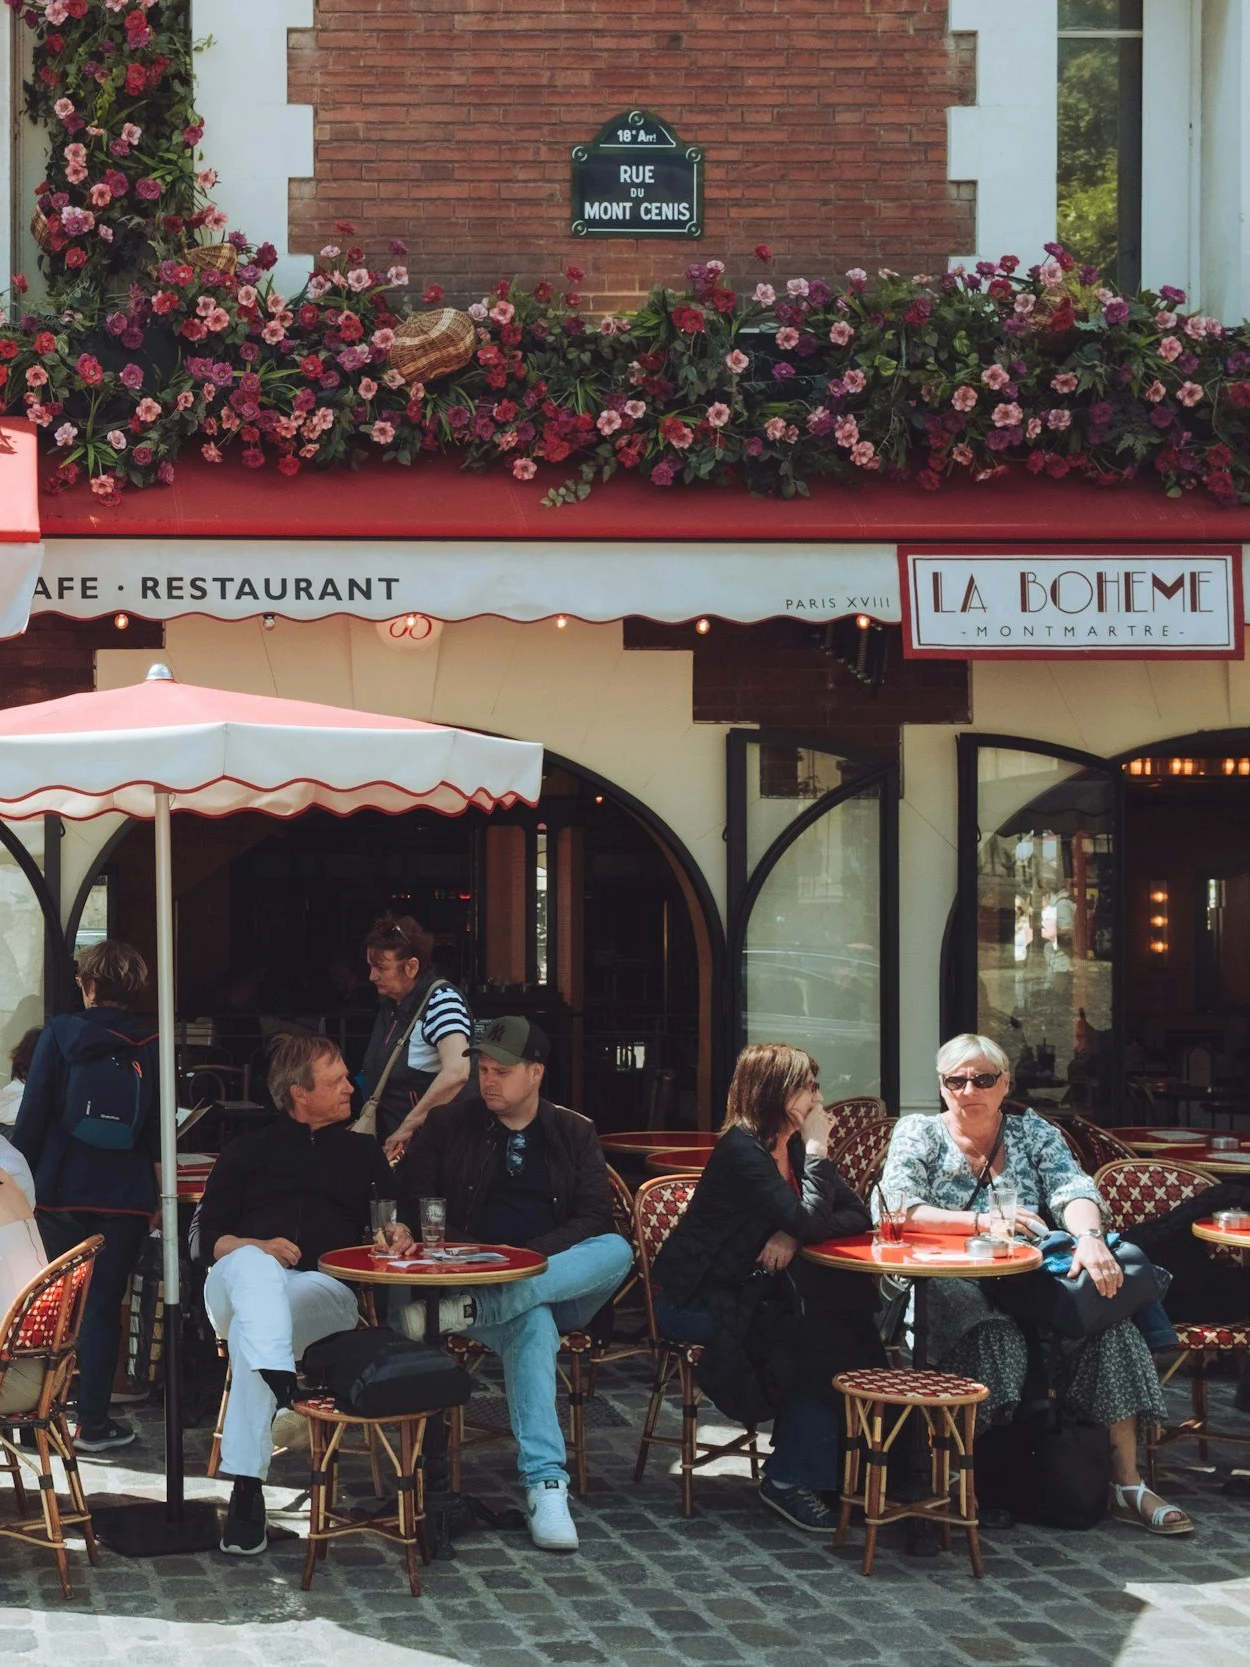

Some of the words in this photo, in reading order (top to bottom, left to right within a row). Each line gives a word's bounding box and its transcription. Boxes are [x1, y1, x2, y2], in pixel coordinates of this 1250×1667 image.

[620, 165, 655, 183] RUE
[630, 188, 645, 198] DU
[584, 201, 633, 220] MONT
[640, 202, 691, 220] CENIS
[33, 576, 99, 600] AFE
[141, 576, 401, 601] RESTAURANT
[932, 571, 987, 614] LA
[1020, 570, 1214, 614] BOHEME
[786, 598, 836, 610] PARIS
[847, 597, 890, 608] XVIII
